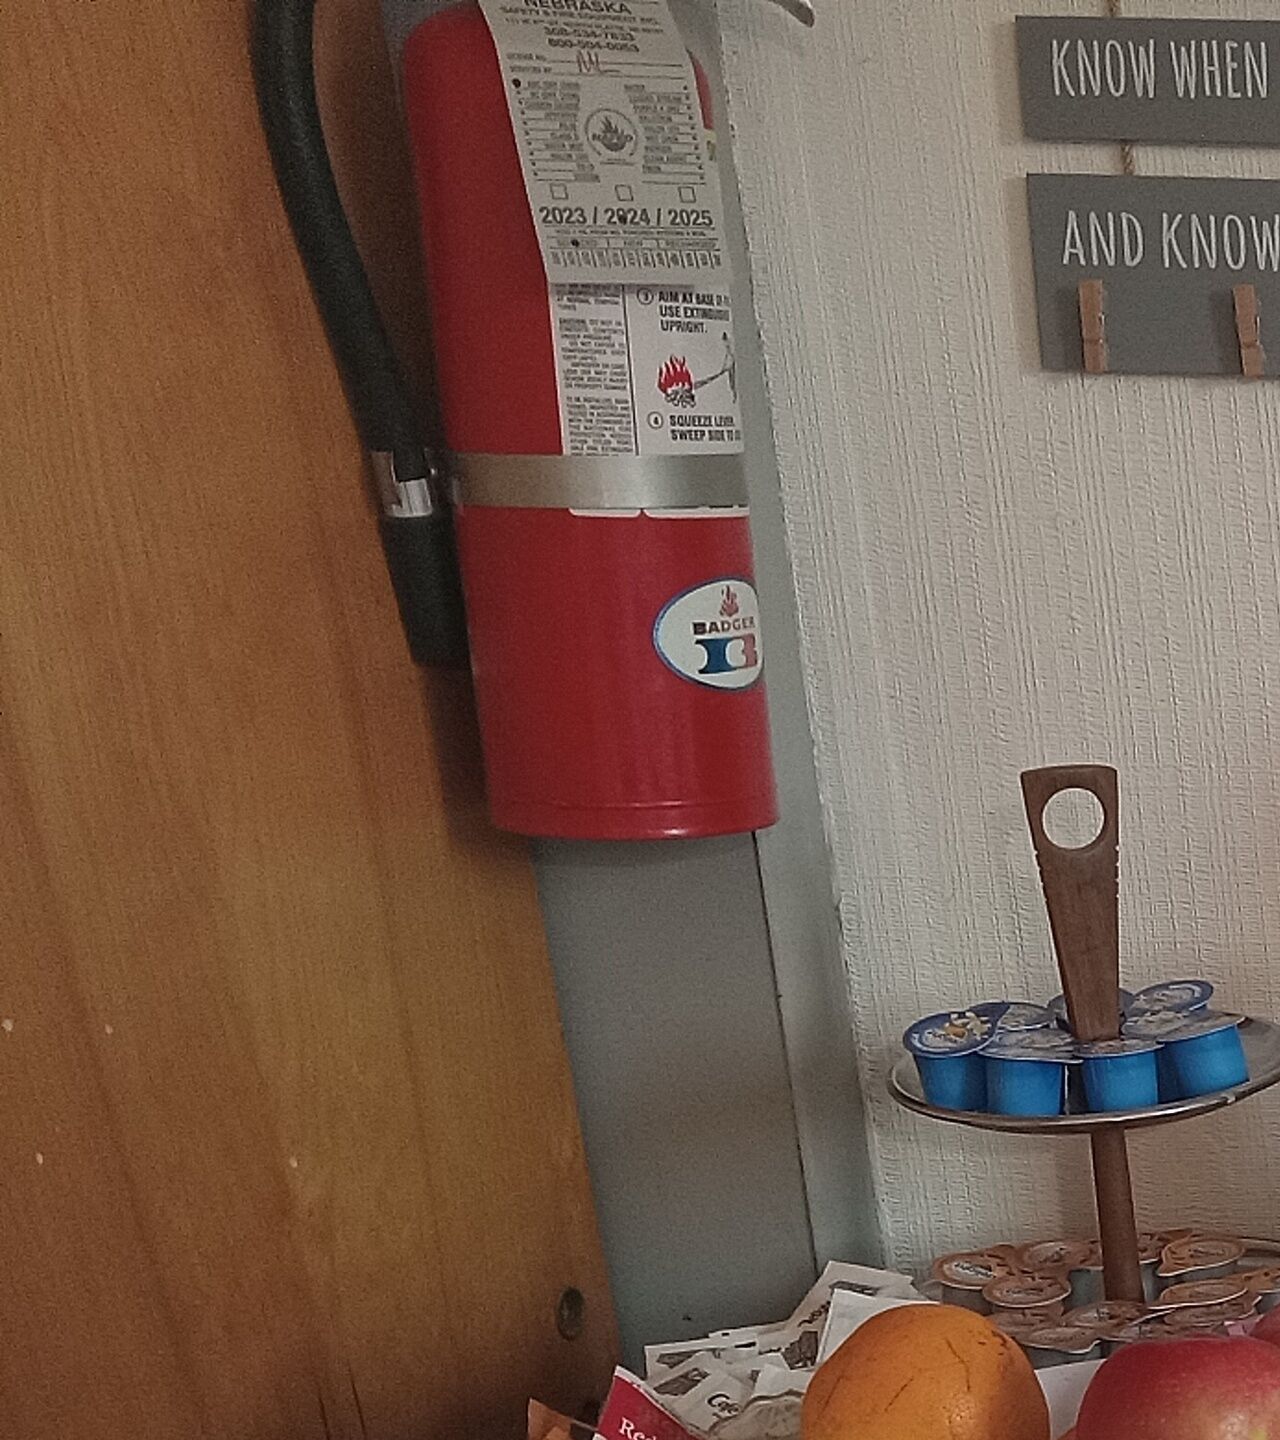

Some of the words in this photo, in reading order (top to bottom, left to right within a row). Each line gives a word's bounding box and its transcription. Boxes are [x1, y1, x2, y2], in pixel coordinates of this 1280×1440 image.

[524, 0, 632, 15] NEBRASKA
[1051, 38, 1157, 99] KNOW
[1169, 39, 1269, 99] WHEN
[539, 206, 587, 225] 2023
[604, 207, 650, 226] 2024
[668, 208, 713, 227] 2025
[1062, 209, 1145, 267] AND
[658, 291, 680, 303] AIM
[658, 305, 681, 318] USE
[671, 429, 707, 442] SWEEP
